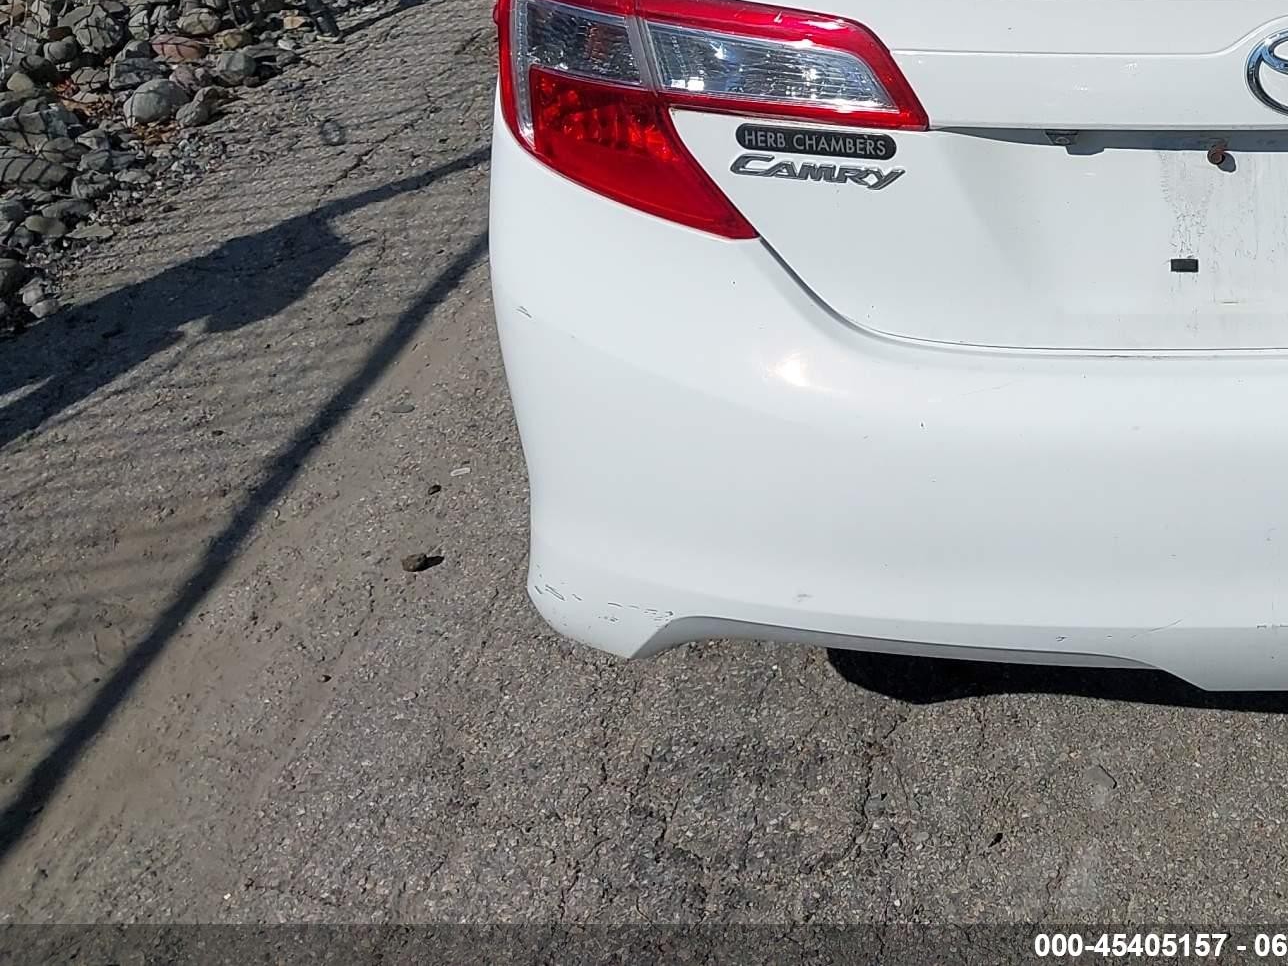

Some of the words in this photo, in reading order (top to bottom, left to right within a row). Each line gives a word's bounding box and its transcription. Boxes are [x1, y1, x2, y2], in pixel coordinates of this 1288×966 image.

[744, 130, 786, 148] HERB
[793, 134, 886, 156] CHAMBERS
[730, 153, 906, 190] CAMRY
